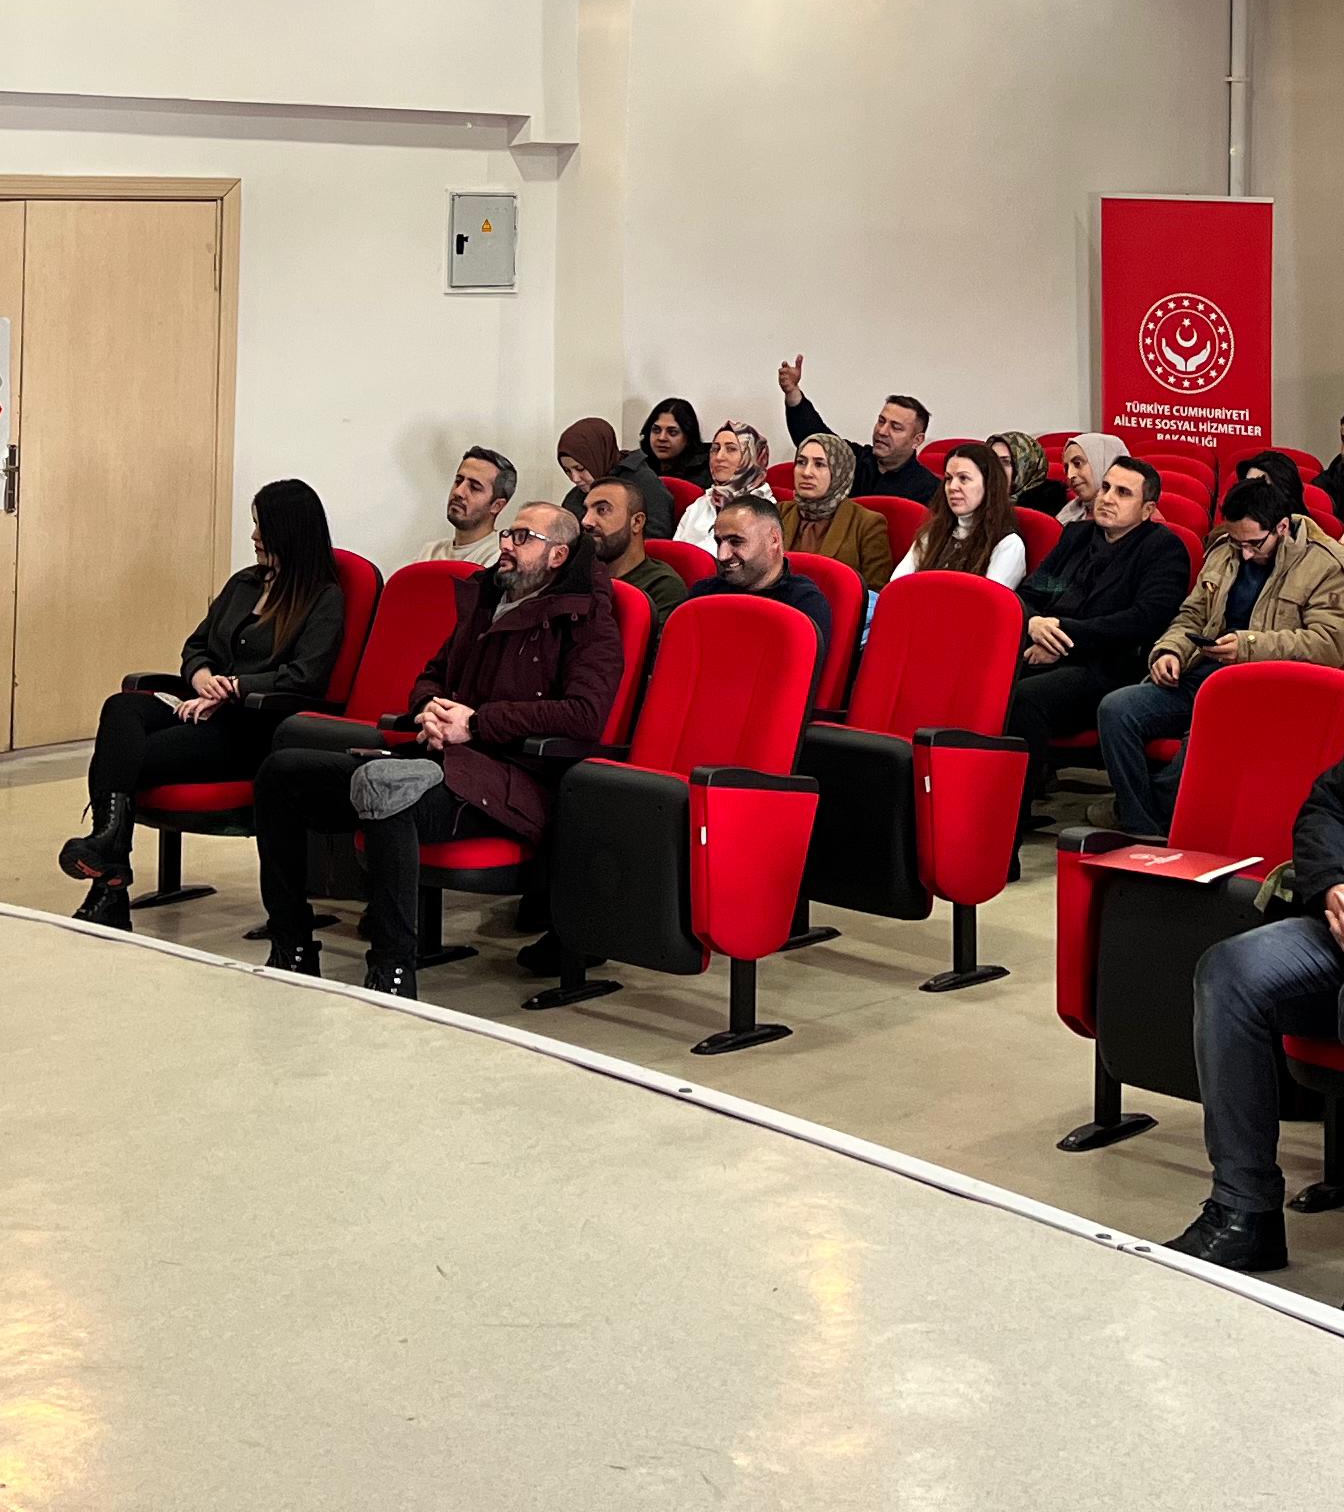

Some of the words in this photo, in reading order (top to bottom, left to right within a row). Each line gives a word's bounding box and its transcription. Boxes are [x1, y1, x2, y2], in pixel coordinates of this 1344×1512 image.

[1126, 401, 1170, 415] TÜRKİYE
[1173, 406, 1249, 421] CUMHURİYETİ
[1114, 414, 1137, 427] AİLE
[1139, 418, 1153, 428] VE
[1155, 419, 1196, 432] SOSYAL
[1199, 420, 1261, 436] HİZMETLER
